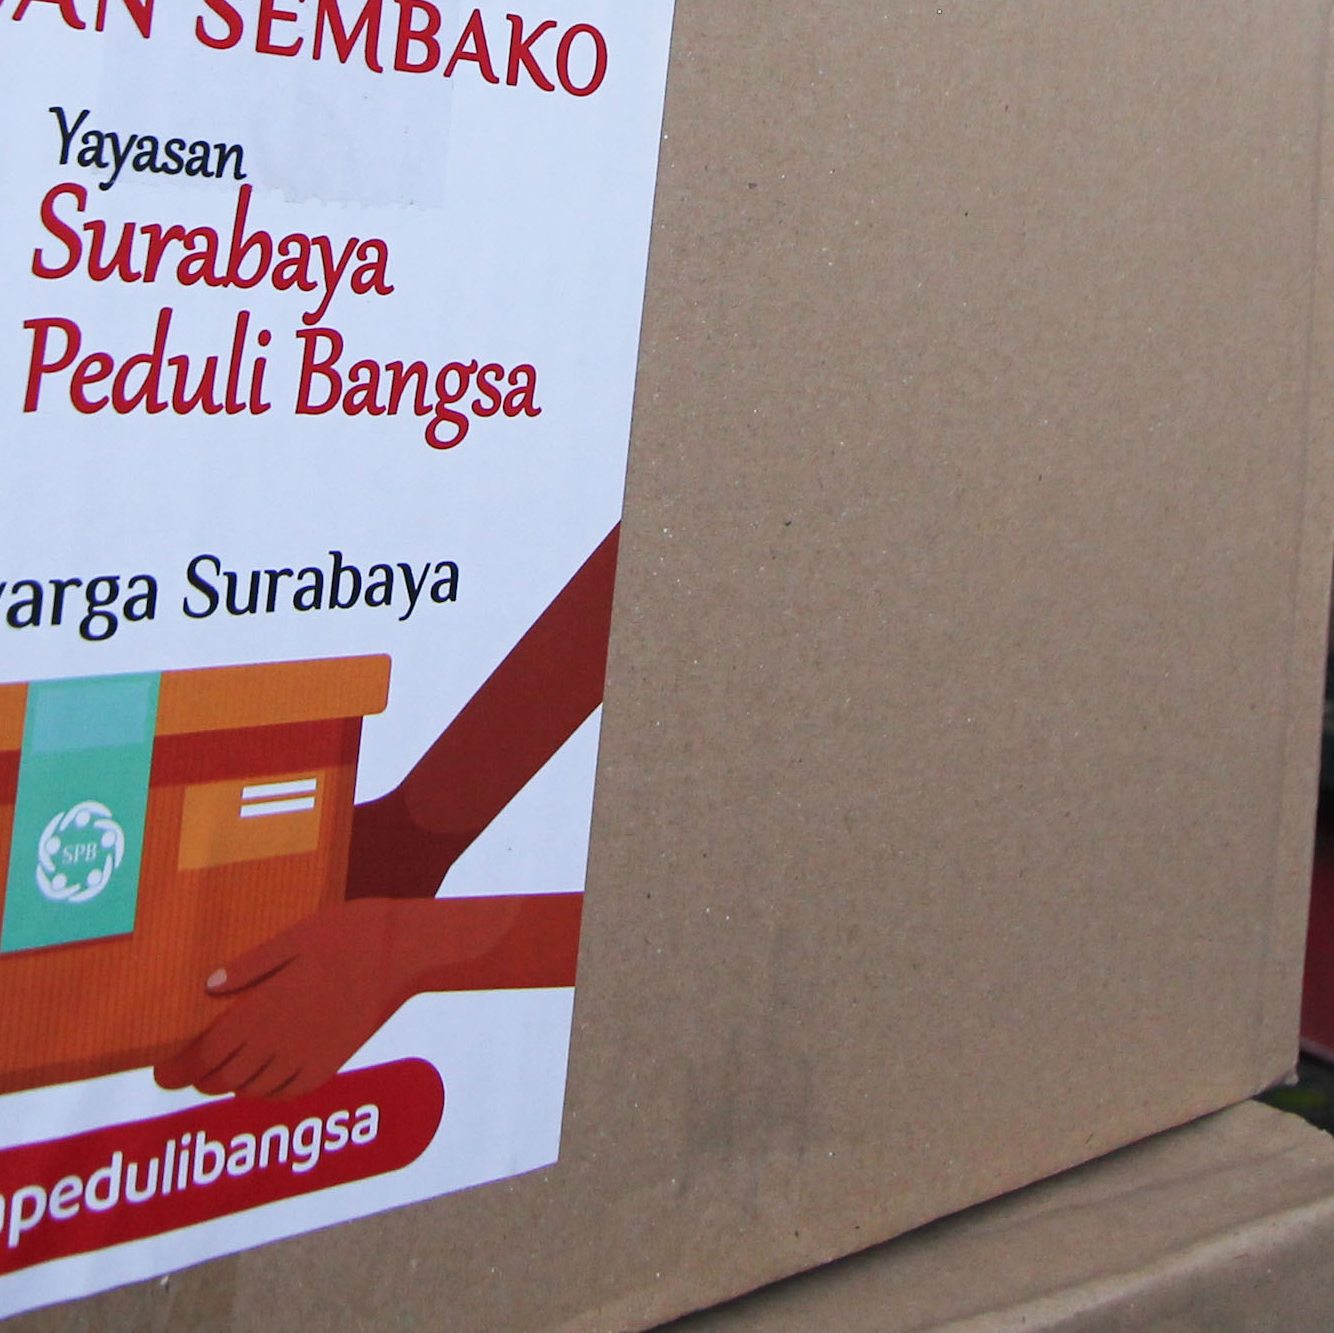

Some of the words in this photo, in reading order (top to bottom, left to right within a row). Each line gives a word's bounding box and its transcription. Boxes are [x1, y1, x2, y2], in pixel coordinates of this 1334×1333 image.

[47, 105, 248, 193] Yayasan
[31, 181, 395, 327] Surabaya
[22, 306, 273, 416] Peduli
[294, 326, 543, 451] Bangsa
[181, 549, 460, 623] Surabaya
[61, 842, 98, 866] SPB
